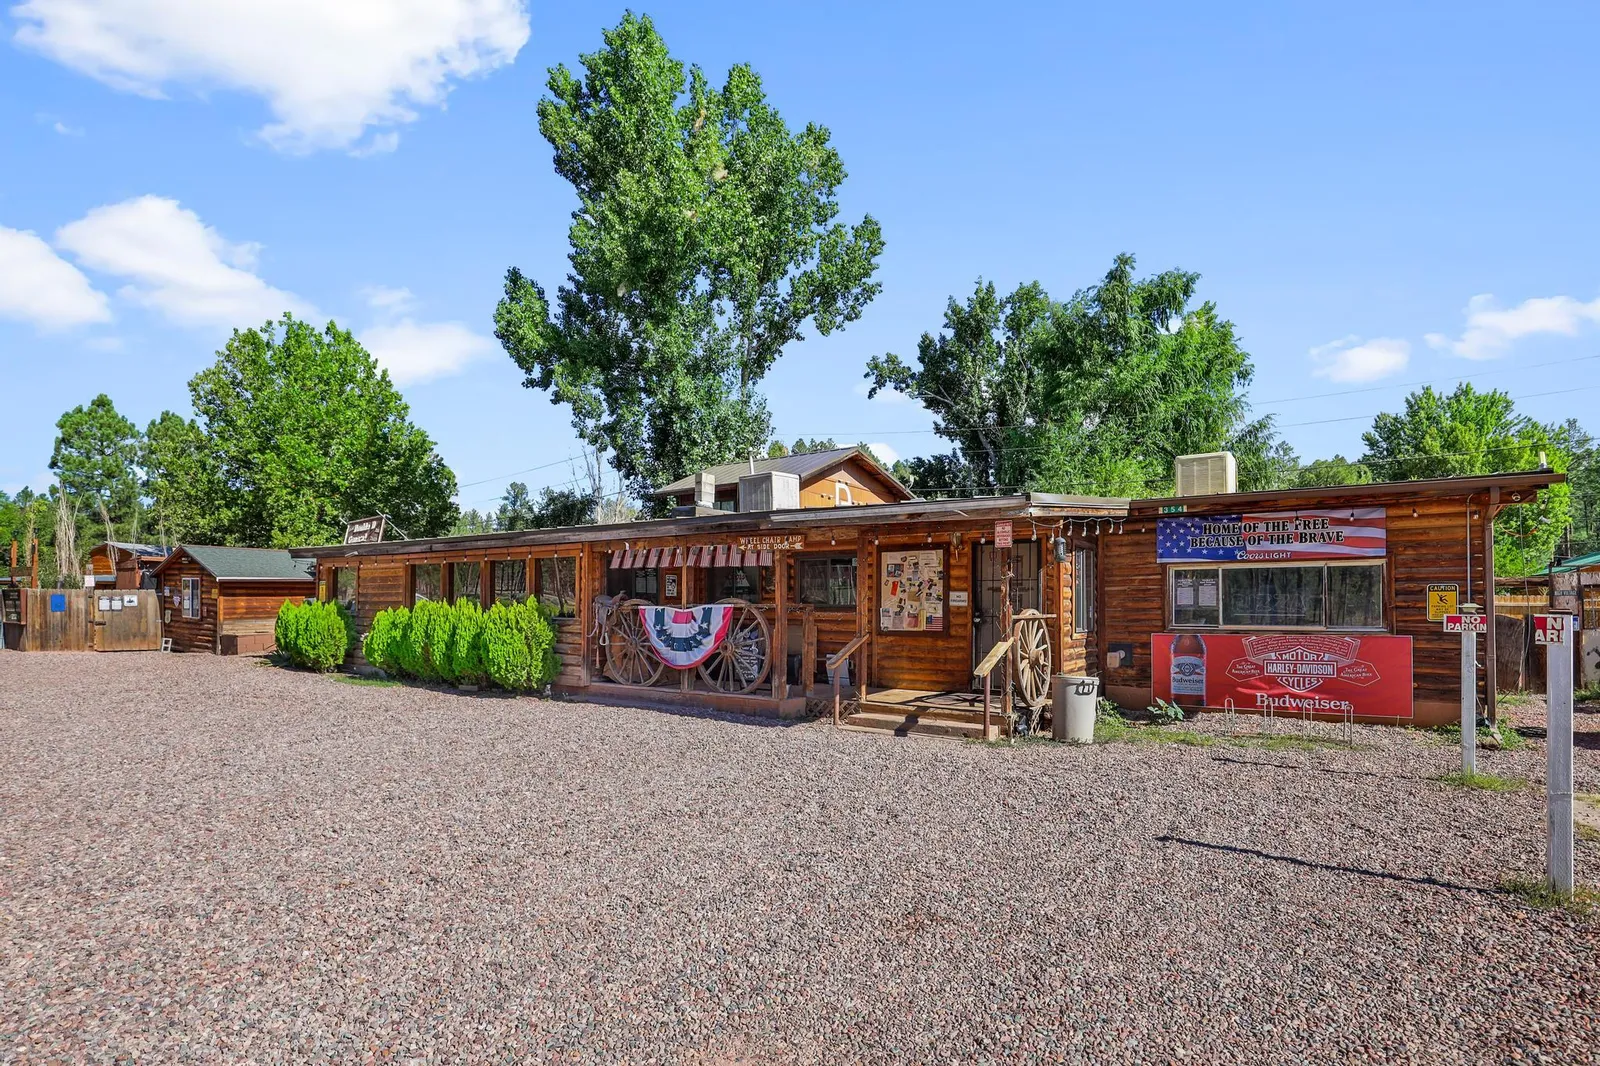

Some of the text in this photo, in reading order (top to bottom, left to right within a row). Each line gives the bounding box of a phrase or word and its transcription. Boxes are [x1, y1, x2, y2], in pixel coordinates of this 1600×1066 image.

[1202, 518, 1329, 535] HOME OF THE FREE
[762, 535, 781, 544] CHAIR
[1190, 530, 1344, 548] BECAUSE OF THE BRAVE
[1236, 551, 1264, 560] Coors
[1462, 616, 1481, 624] NO
[1447, 623, 1487, 631] PARKIN
[1282, 648, 1317, 660] MOTOR
[1267, 663, 1333, 675] HARLEY-DAVIDSON
[1282, 677, 1318, 690] CYCLES
[1256, 692, 1349, 710] Budweiser
